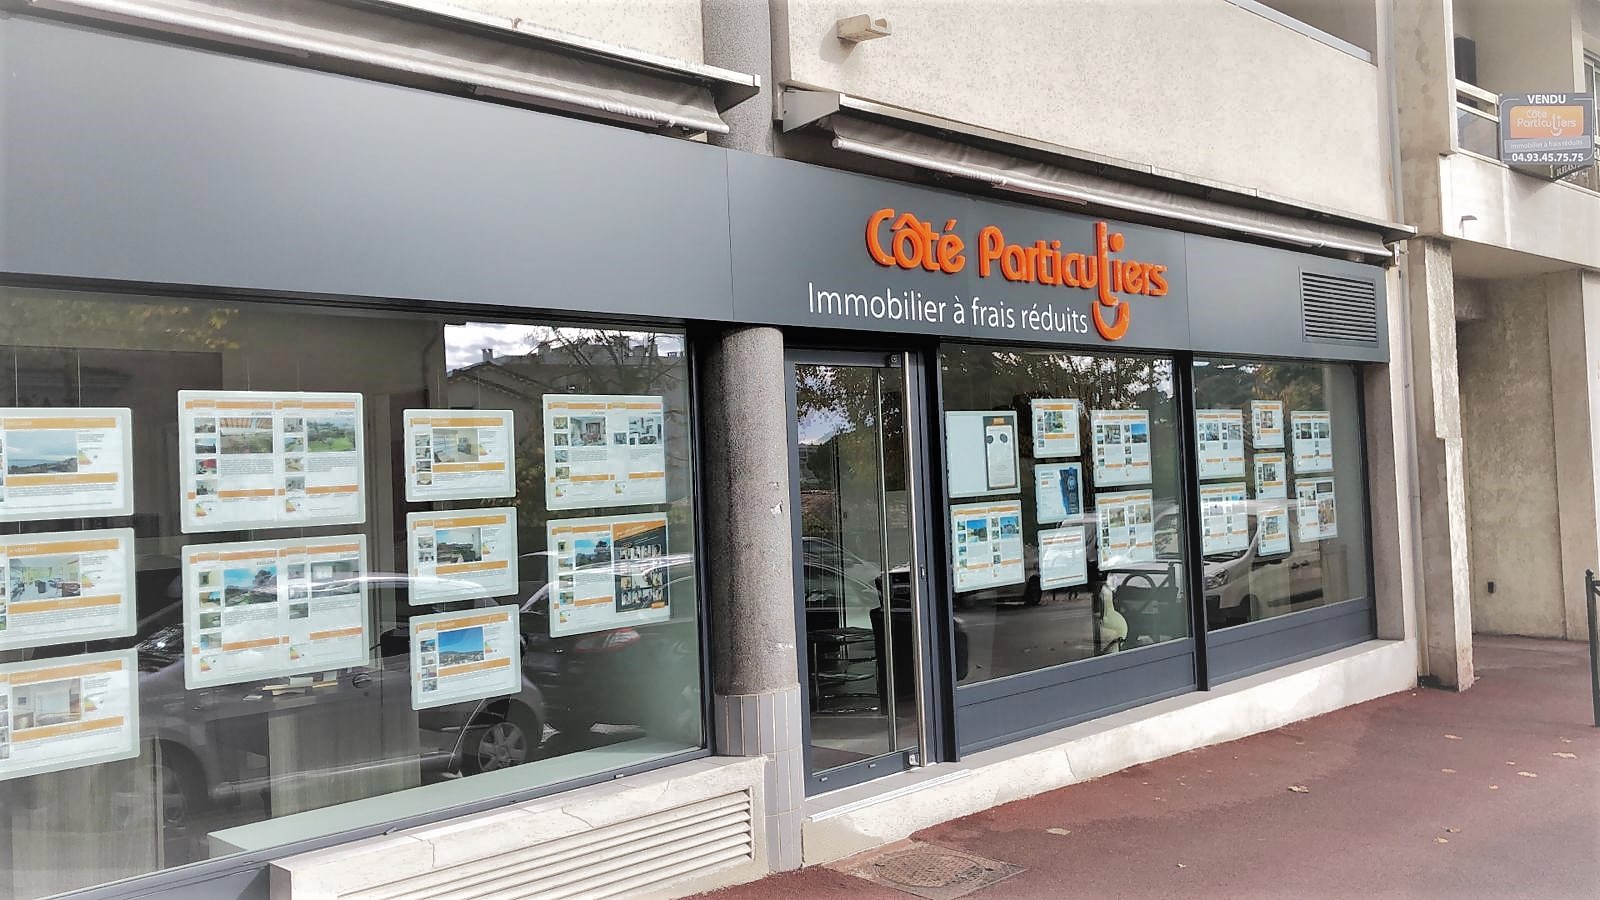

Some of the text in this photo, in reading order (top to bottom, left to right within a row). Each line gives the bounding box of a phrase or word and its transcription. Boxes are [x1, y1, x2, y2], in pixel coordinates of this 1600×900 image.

[1527, 94, 1567, 104] VENDU
[1516, 113, 1577, 130] Particuliers
[1511, 153, 1584, 162] 04.93.45.75.75
[866, 208, 1169, 308] Côté Particuliers
[808, 281, 1088, 334] Immobilier à frais réduits
